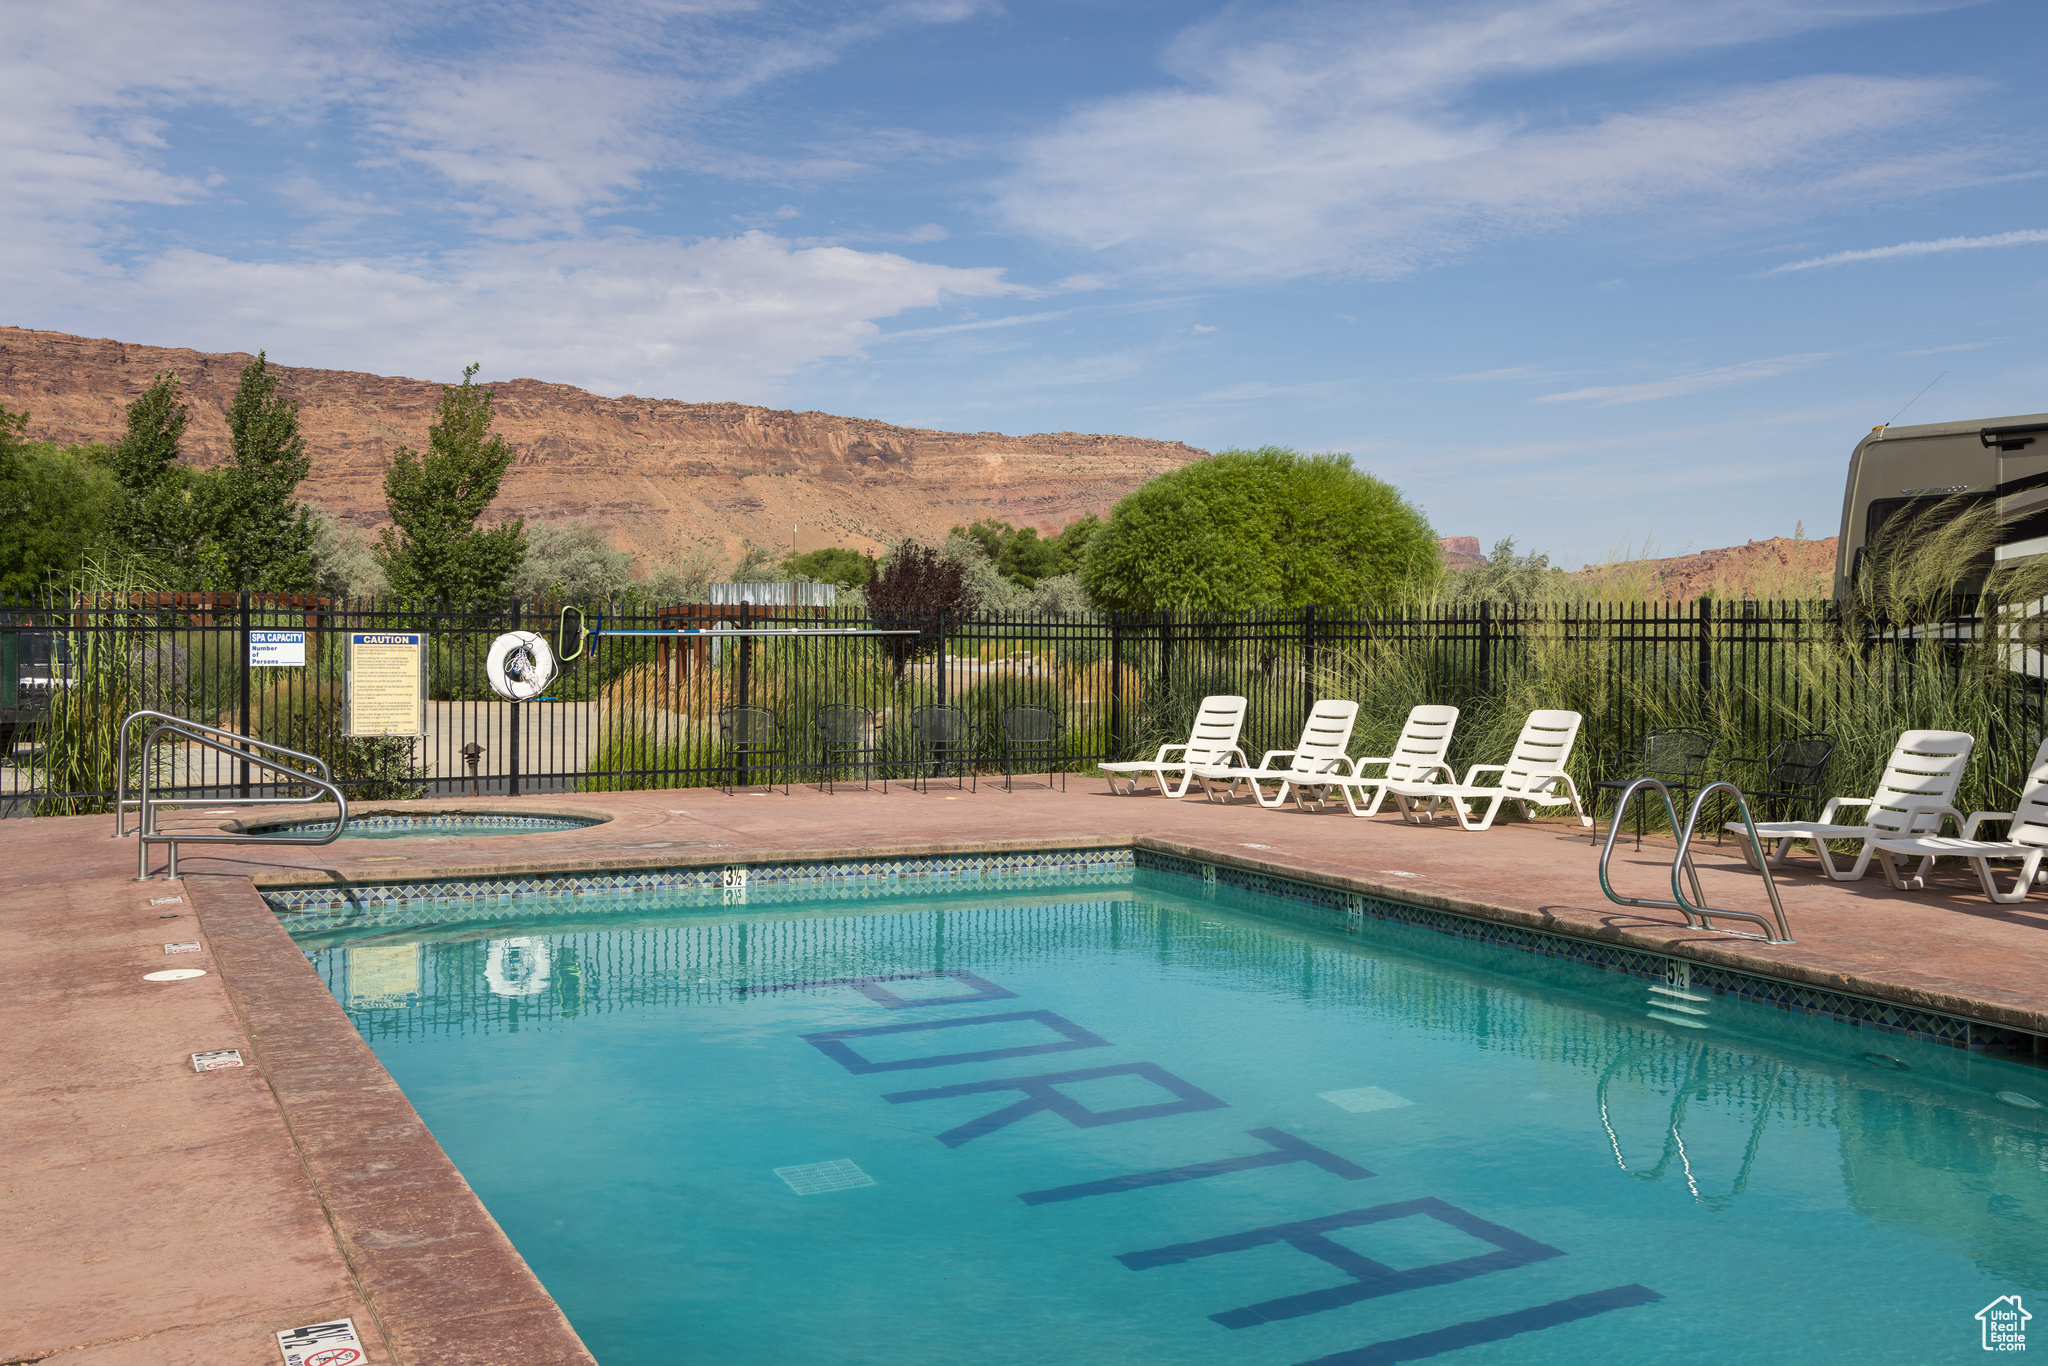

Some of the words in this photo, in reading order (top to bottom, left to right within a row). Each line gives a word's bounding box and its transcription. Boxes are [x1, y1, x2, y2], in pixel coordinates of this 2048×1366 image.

[251, 633, 266, 642] SPA
[267, 633, 303, 642] CAPACITY
[363, 635, 410, 644] CAUTION
